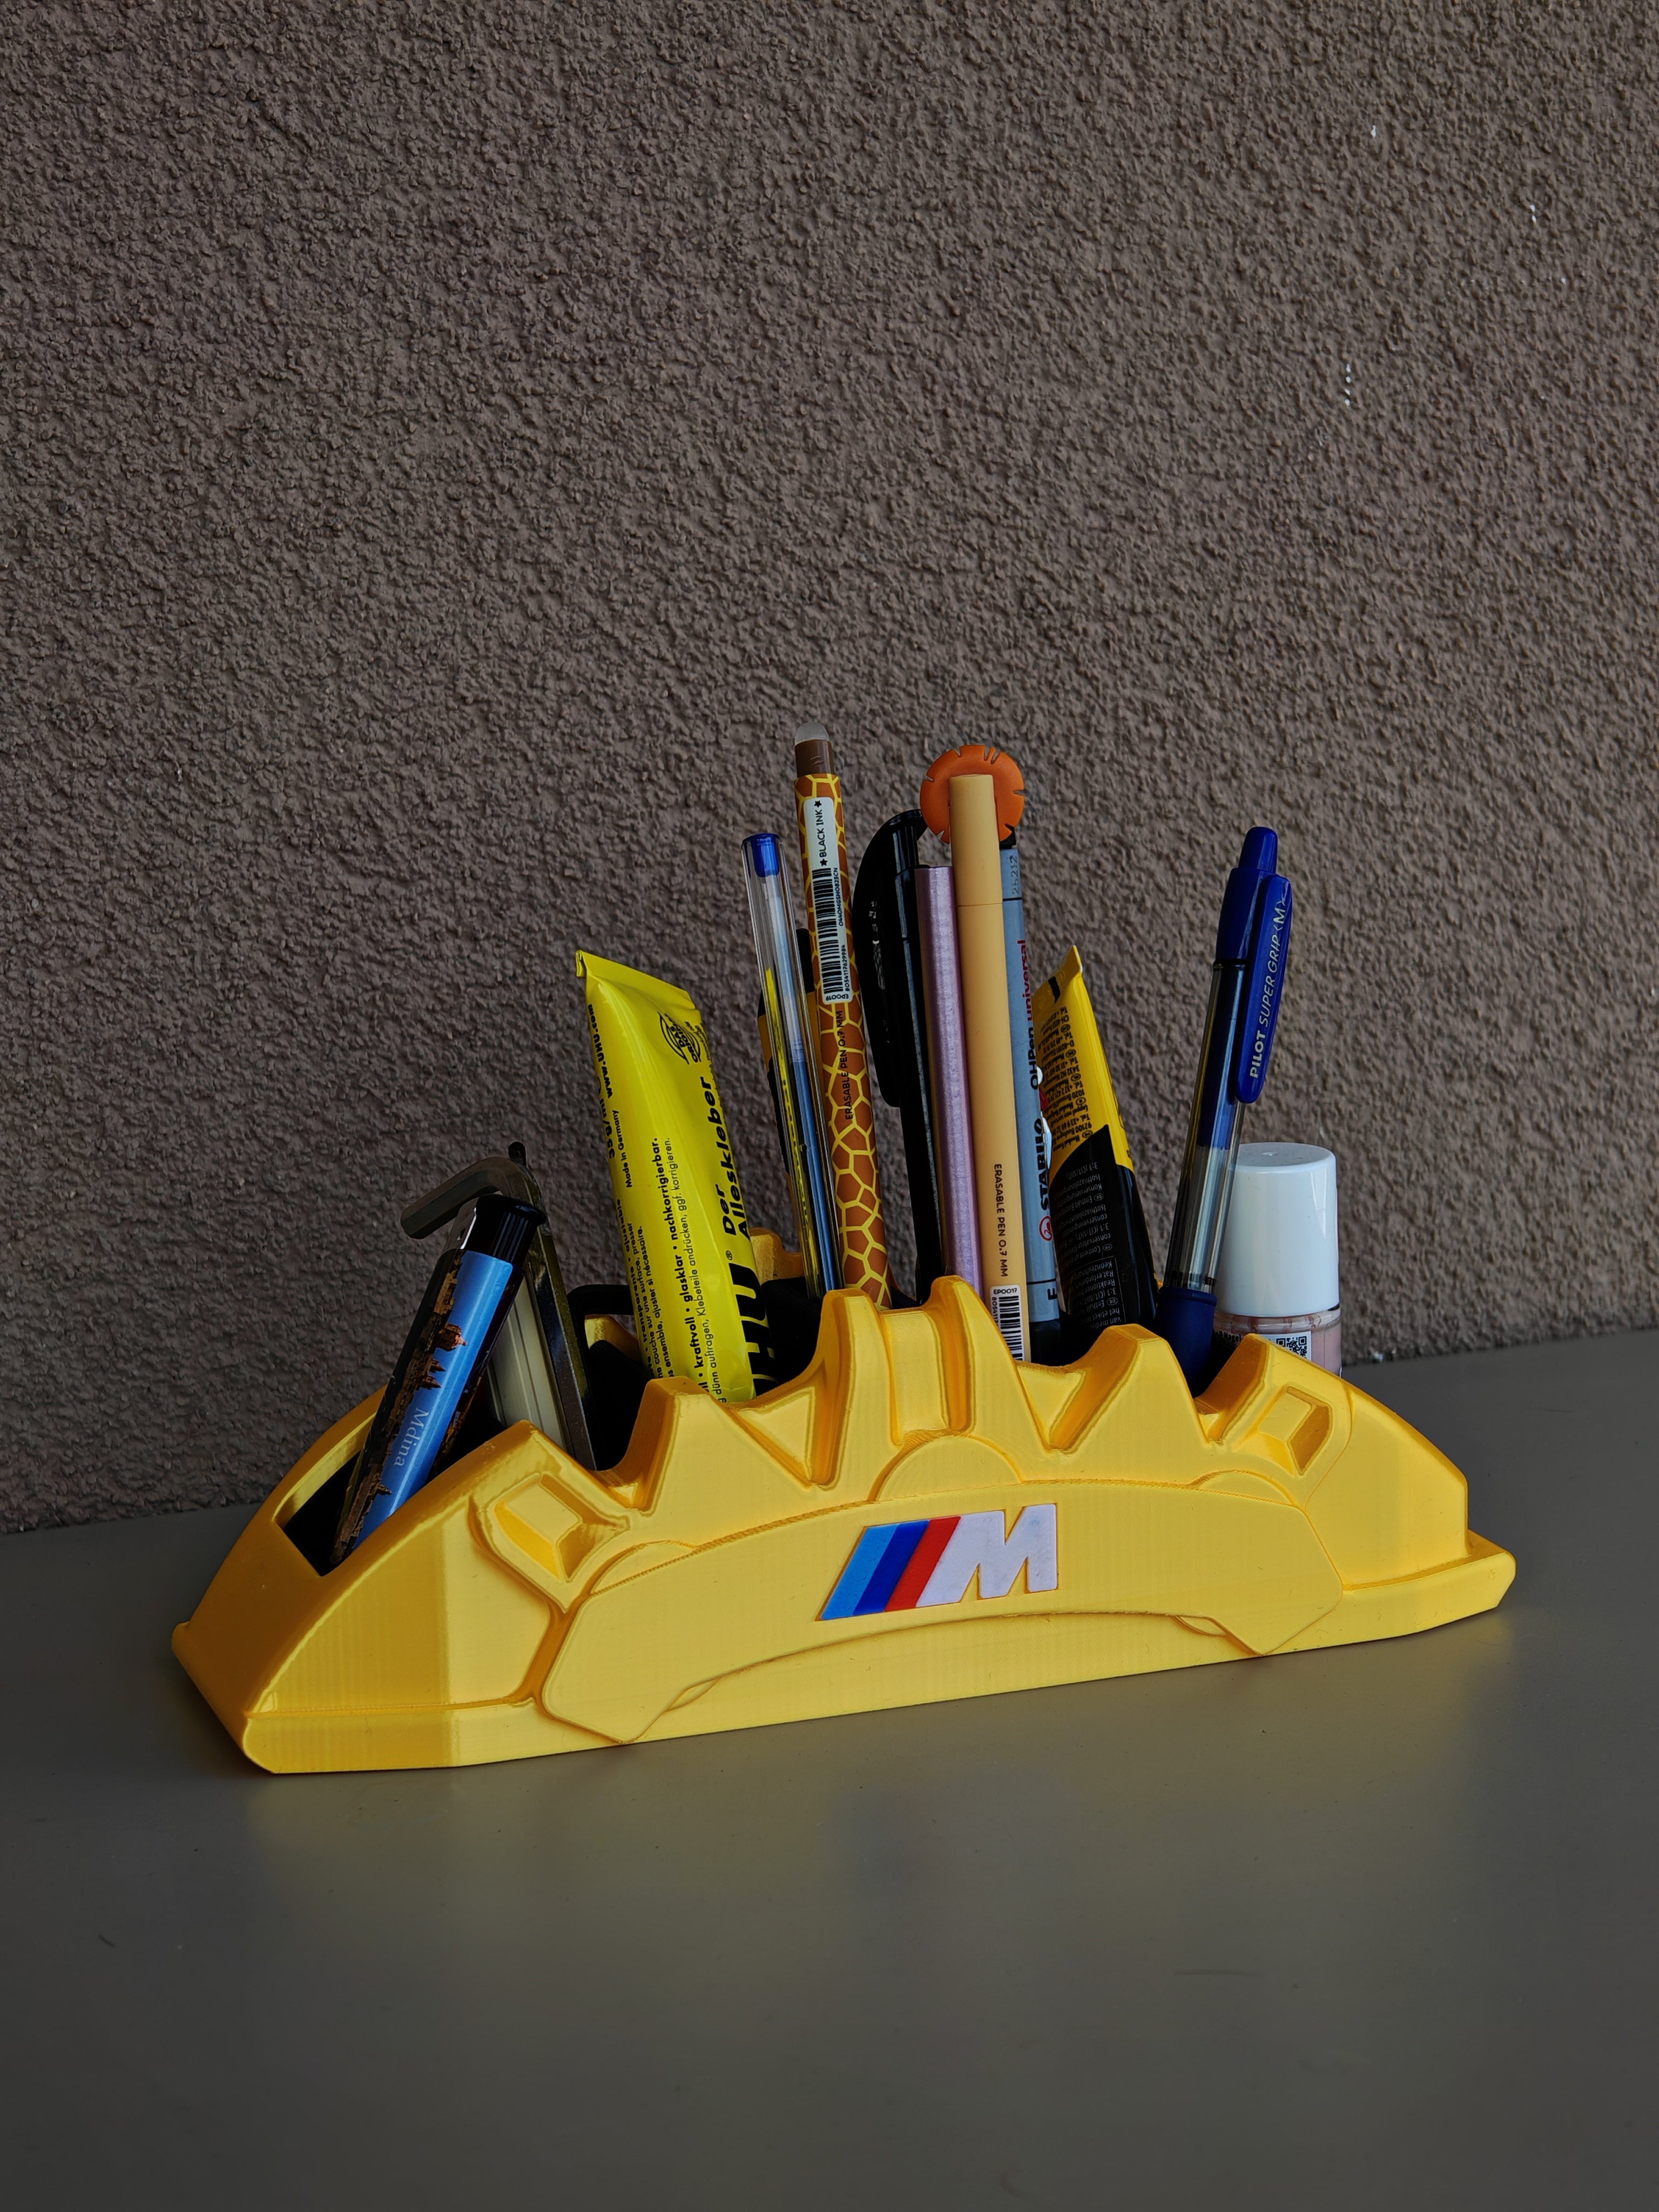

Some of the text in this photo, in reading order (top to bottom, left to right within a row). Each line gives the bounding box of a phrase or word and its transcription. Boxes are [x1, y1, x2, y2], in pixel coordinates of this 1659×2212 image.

[815, 810, 827, 858] BLACK INK
[1250, 1030, 1265, 1078] PILOT
[1259, 976, 1275, 1027] SUPER
[1268, 933, 1280, 973] GRIP
[588, 1004, 612, 1098] www.UHU.com
[669, 1025, 685, 1047] DAS
[835, 1009, 853, 1120] ERASABLE PEN 0.7 MM
[1017, 940, 1050, 1210] STABILO OHPen universal
[606, 1138, 615, 1159] 35
[612, 1110, 632, 1188] Made in Germany
[665, 1138, 680, 1190] korrigieren.
[699, 1076, 751, 1241] Alleskleber
[1089, 1162, 1098, 1171] 3:1
[652, 1138, 678, 1240] nachkorrigierbar.
[672, 1193, 687, 1211] ggf.
[715, 1184, 736, 1236] Der
[617, 1199, 630, 1252] ajustable
[627, 1223, 639, 1255] presser
[679, 1215, 696, 1266] andrücken,
[994, 1164, 1008, 1277] ERASABLE PEN 0.7 MM
[1100, 1223, 1109, 1231] 3:1
[636, 1258, 645, 1293] surface,
[637, 1226, 651, 1277] nécessaire.
[1103, 1270, 1114, 1278] Rat
[675, 1255, 693, 1302] glasklar
[689, 1270, 706, 1316] Klebeteile
[1084, 1276, 1115, 1294] Reaktionen
[1107, 1287, 1116, 1296] 3:1
[630, 1266, 648, 1343] transparente
[650, 1289, 660, 1318] ajuster
[1109, 1307, 1120, 1316] het
[649, 1331, 660, 1365] couche
[656, 1321, 671, 1367] ensemble,
[684, 1317, 704, 1368] kraftvoll
[703, 1319, 717, 1368] auftragen,
[711, 1372, 722, 1395] dünn
[394, 1407, 429, 1466] Mdina
